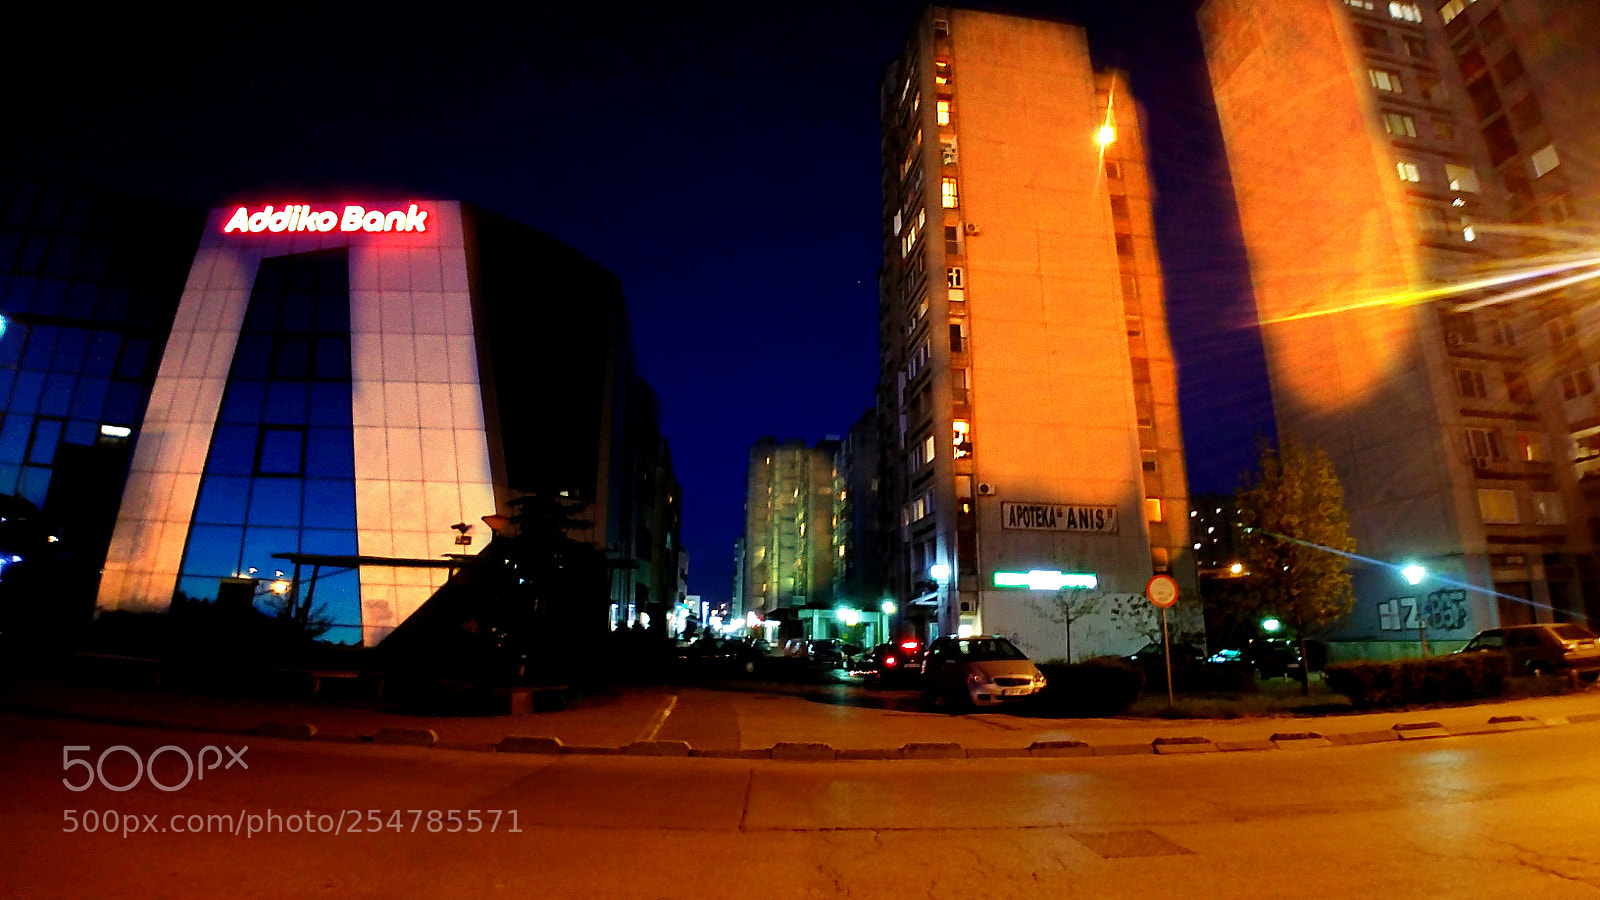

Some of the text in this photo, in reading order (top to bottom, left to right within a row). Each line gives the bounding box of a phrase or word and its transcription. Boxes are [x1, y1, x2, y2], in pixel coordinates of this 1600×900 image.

[224, 204, 428, 233] Addiko Bank
[1009, 505, 1056, 528] APOTEKA
